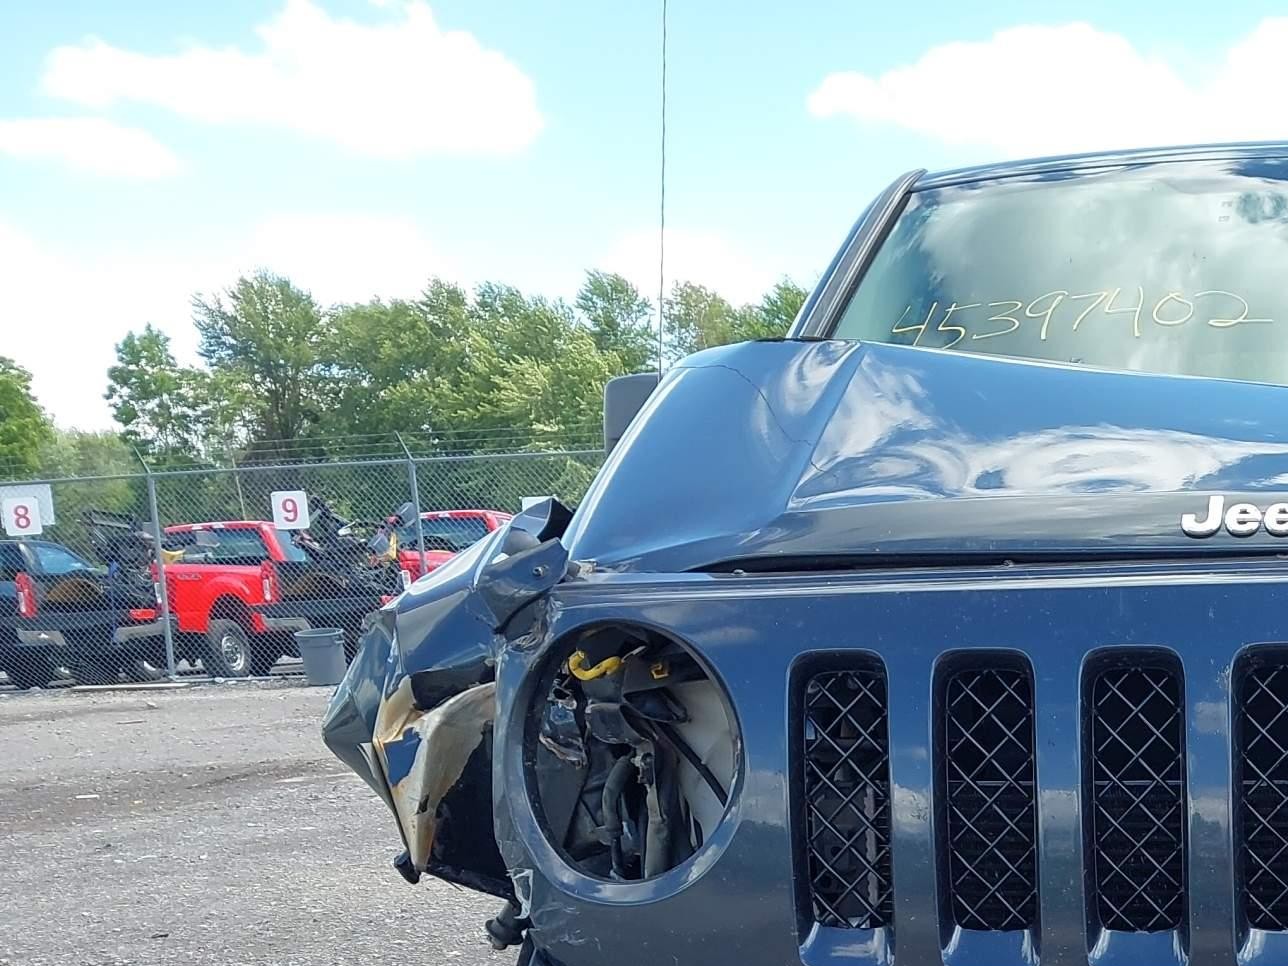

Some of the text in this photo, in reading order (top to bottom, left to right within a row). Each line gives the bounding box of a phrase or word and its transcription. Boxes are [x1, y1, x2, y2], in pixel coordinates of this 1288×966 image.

[892, 286, 1273, 350] 45397402
[14, 504, 31, 529] 8
[281, 498, 298, 523] 9
